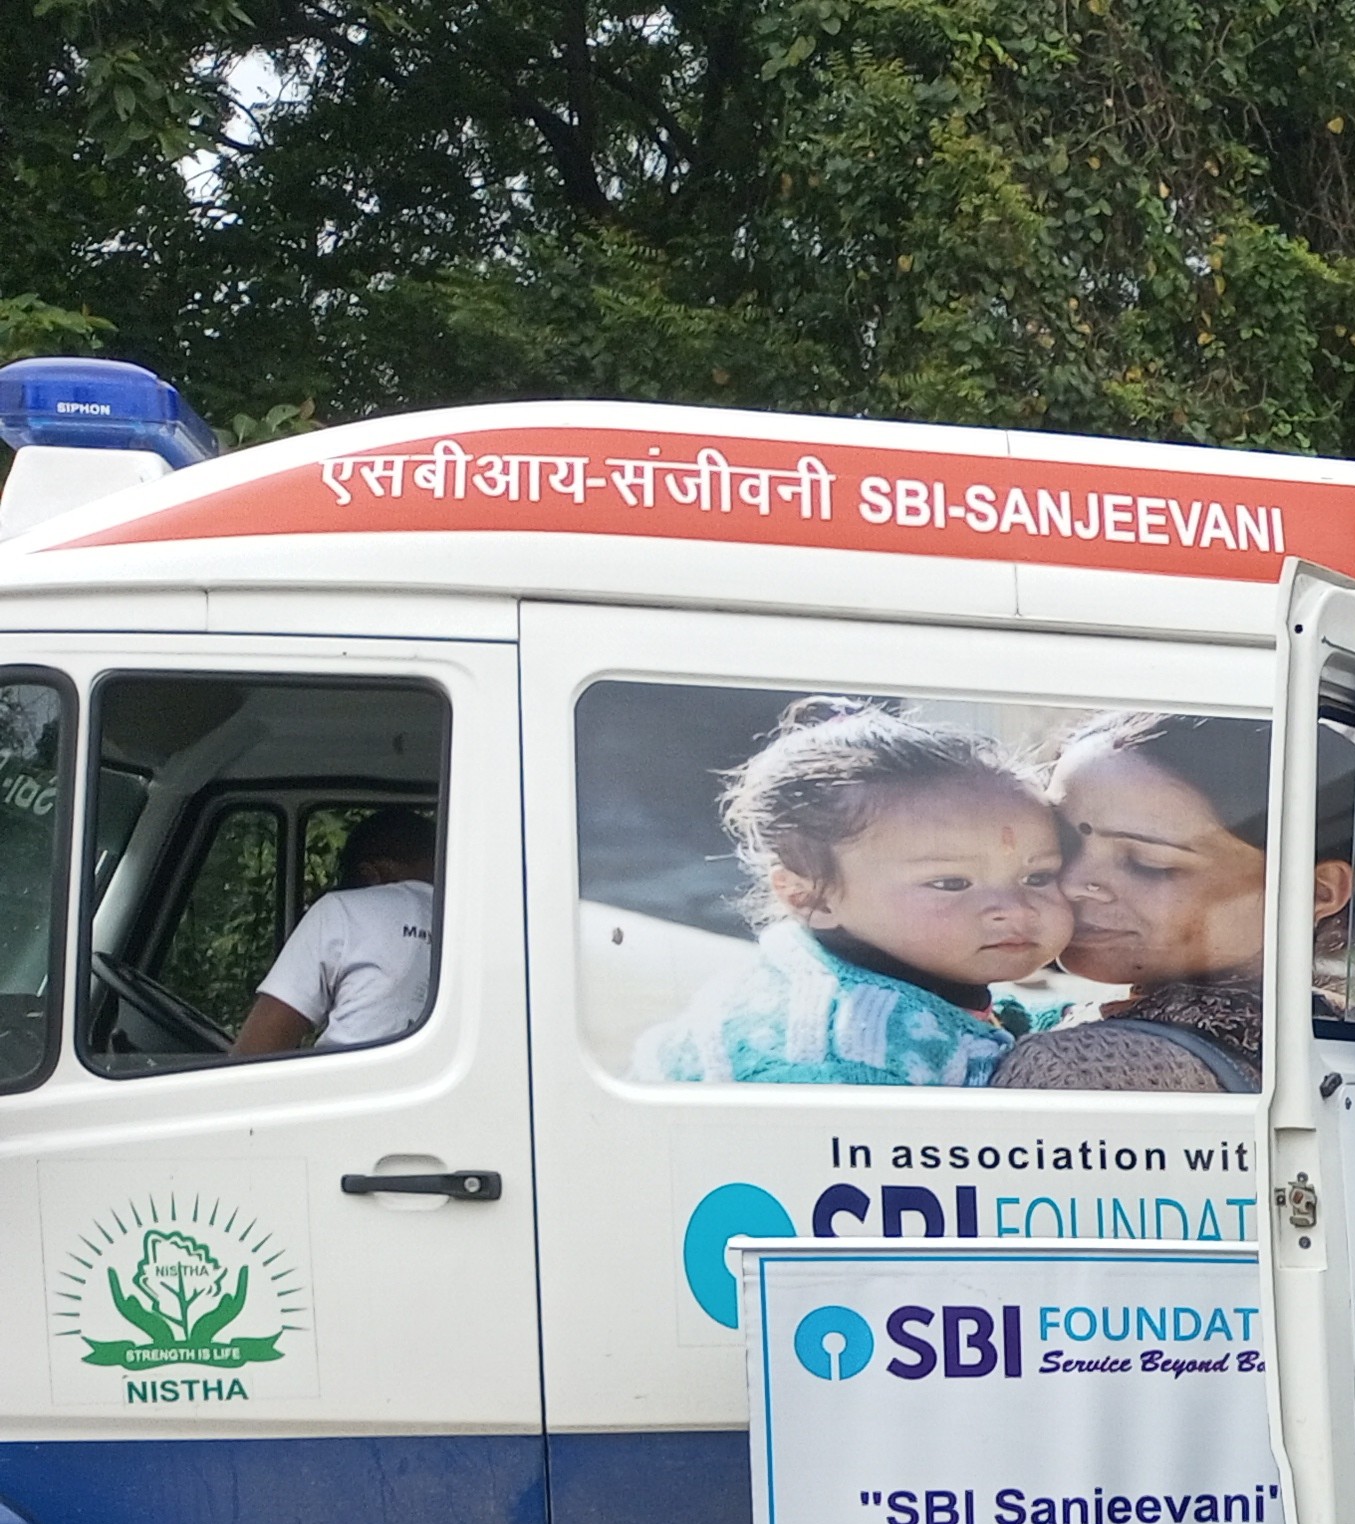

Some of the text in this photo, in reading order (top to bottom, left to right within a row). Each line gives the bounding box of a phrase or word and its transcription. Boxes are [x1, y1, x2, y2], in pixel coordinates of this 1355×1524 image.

[321, 440, 836, 520] एसबीआय-संजीवनी
[858, 475, 1287, 554] SBI-SANJEEVANI
[831, 1136, 1257, 1172] In association wit
[995, 1196, 1257, 1240] FOUNDAT
[155, 1263, 209, 1277] NISTHA
[126, 1347, 241, 1362] STRENGTH IS LIFE
[885, 1304, 1259, 1380] SBI FOUNDAT
[1038, 1349, 1132, 1374] Service
[1140, 1350, 1231, 1379] Beyond
[126, 1377, 249, 1404] NISTHA
